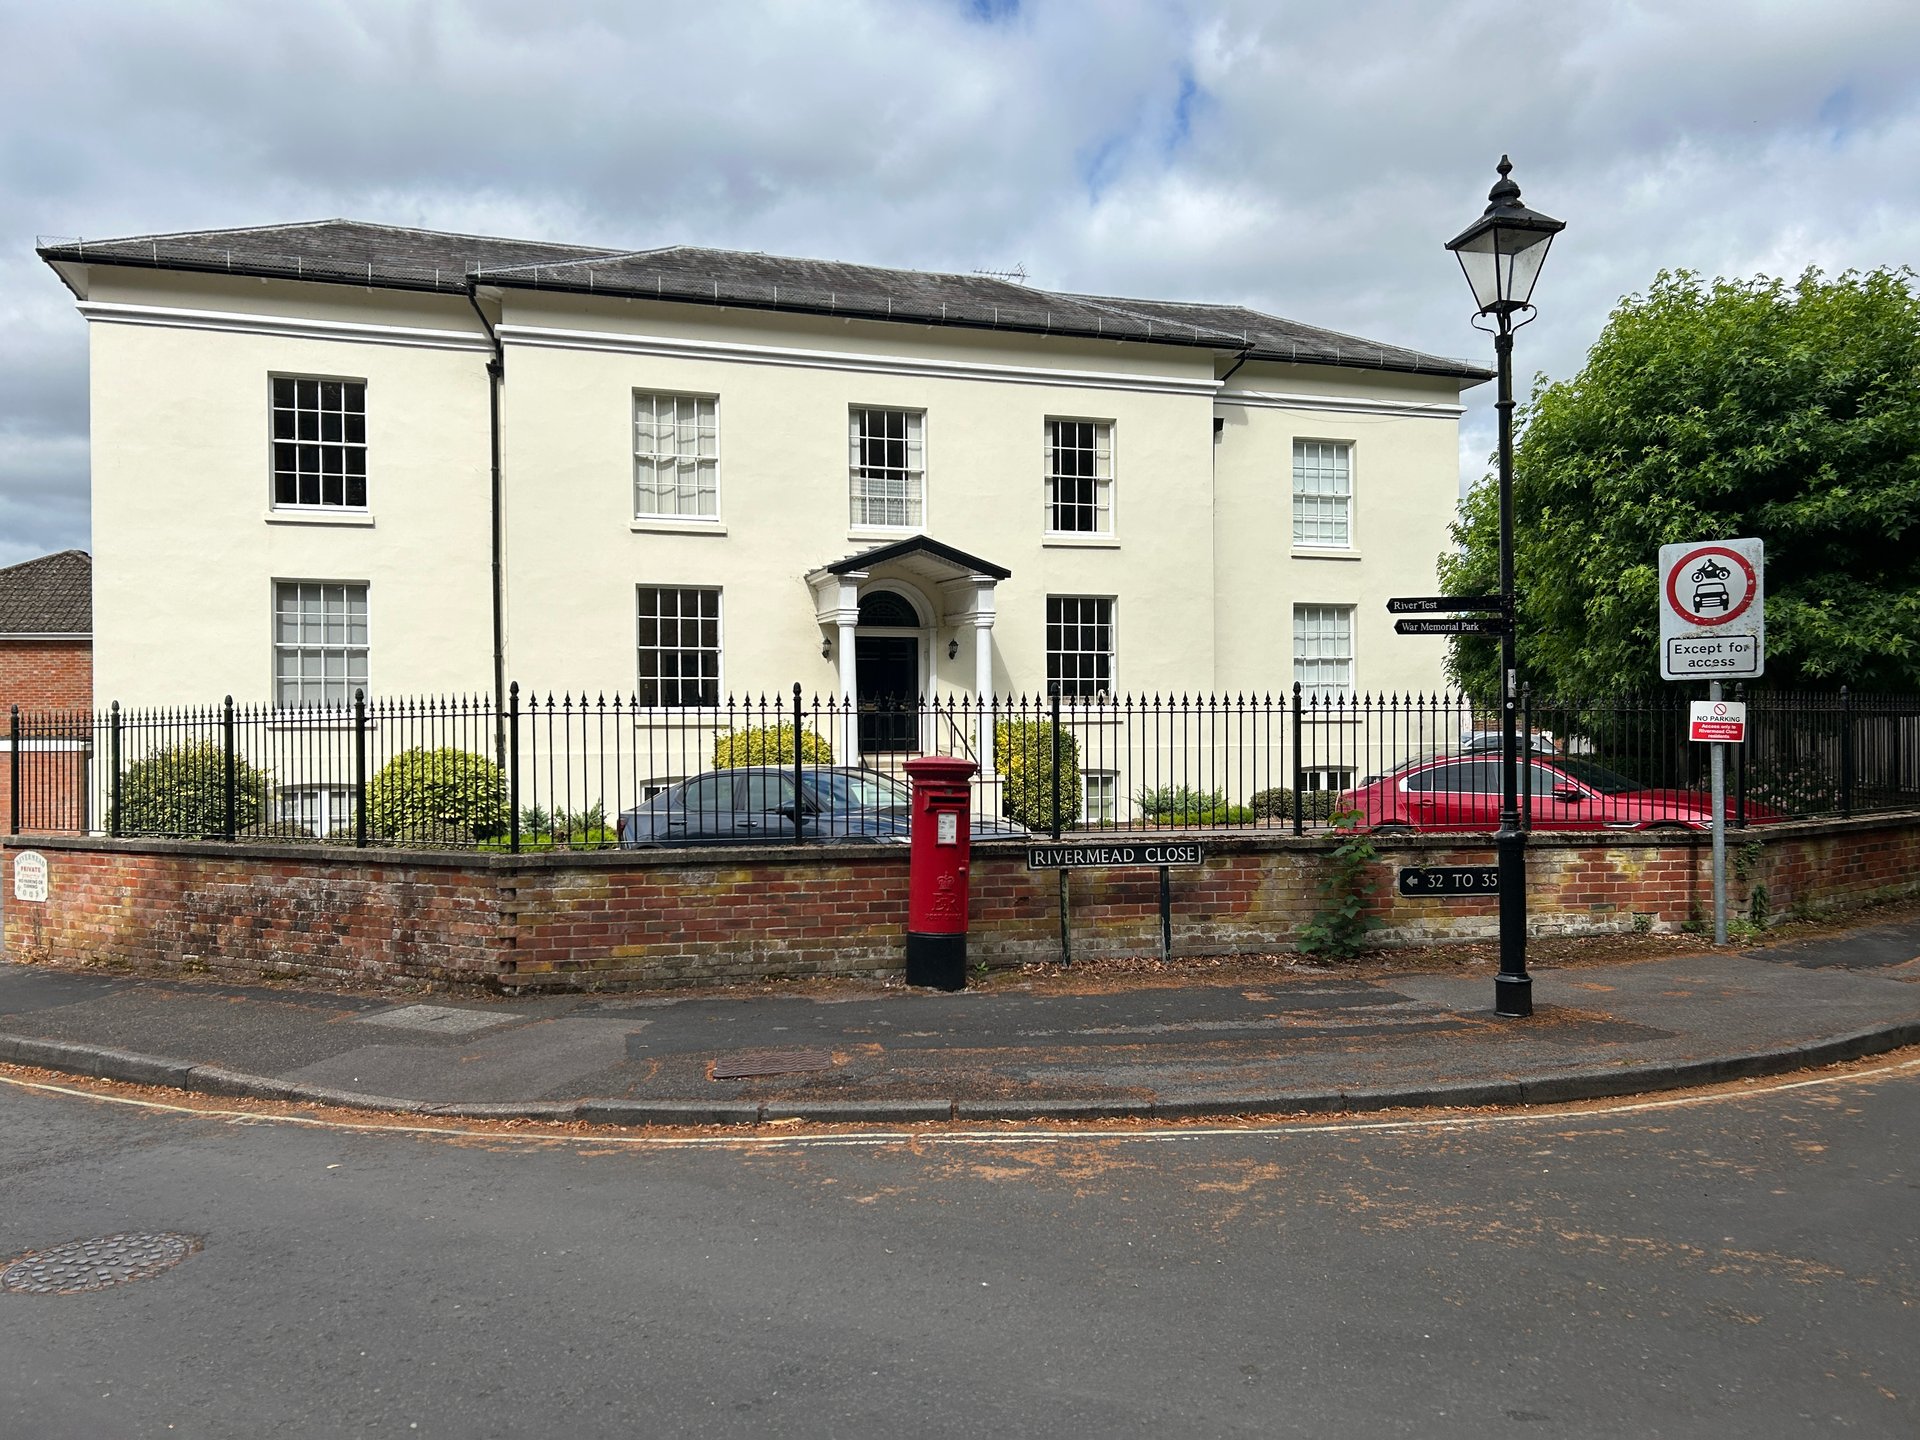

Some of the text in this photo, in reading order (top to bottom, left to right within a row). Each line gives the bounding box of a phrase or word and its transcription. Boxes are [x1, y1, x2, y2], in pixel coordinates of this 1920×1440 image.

[1393, 600, 1437, 610] River Test
[1402, 621, 1479, 631] War Memorial Park
[1674, 643, 1722, 655] Except
[1688, 658, 1735, 668] access
[1034, 847, 1195, 865] RIVERMEAD CLOSE
[1427, 873, 1498, 888] 32 TO 35
